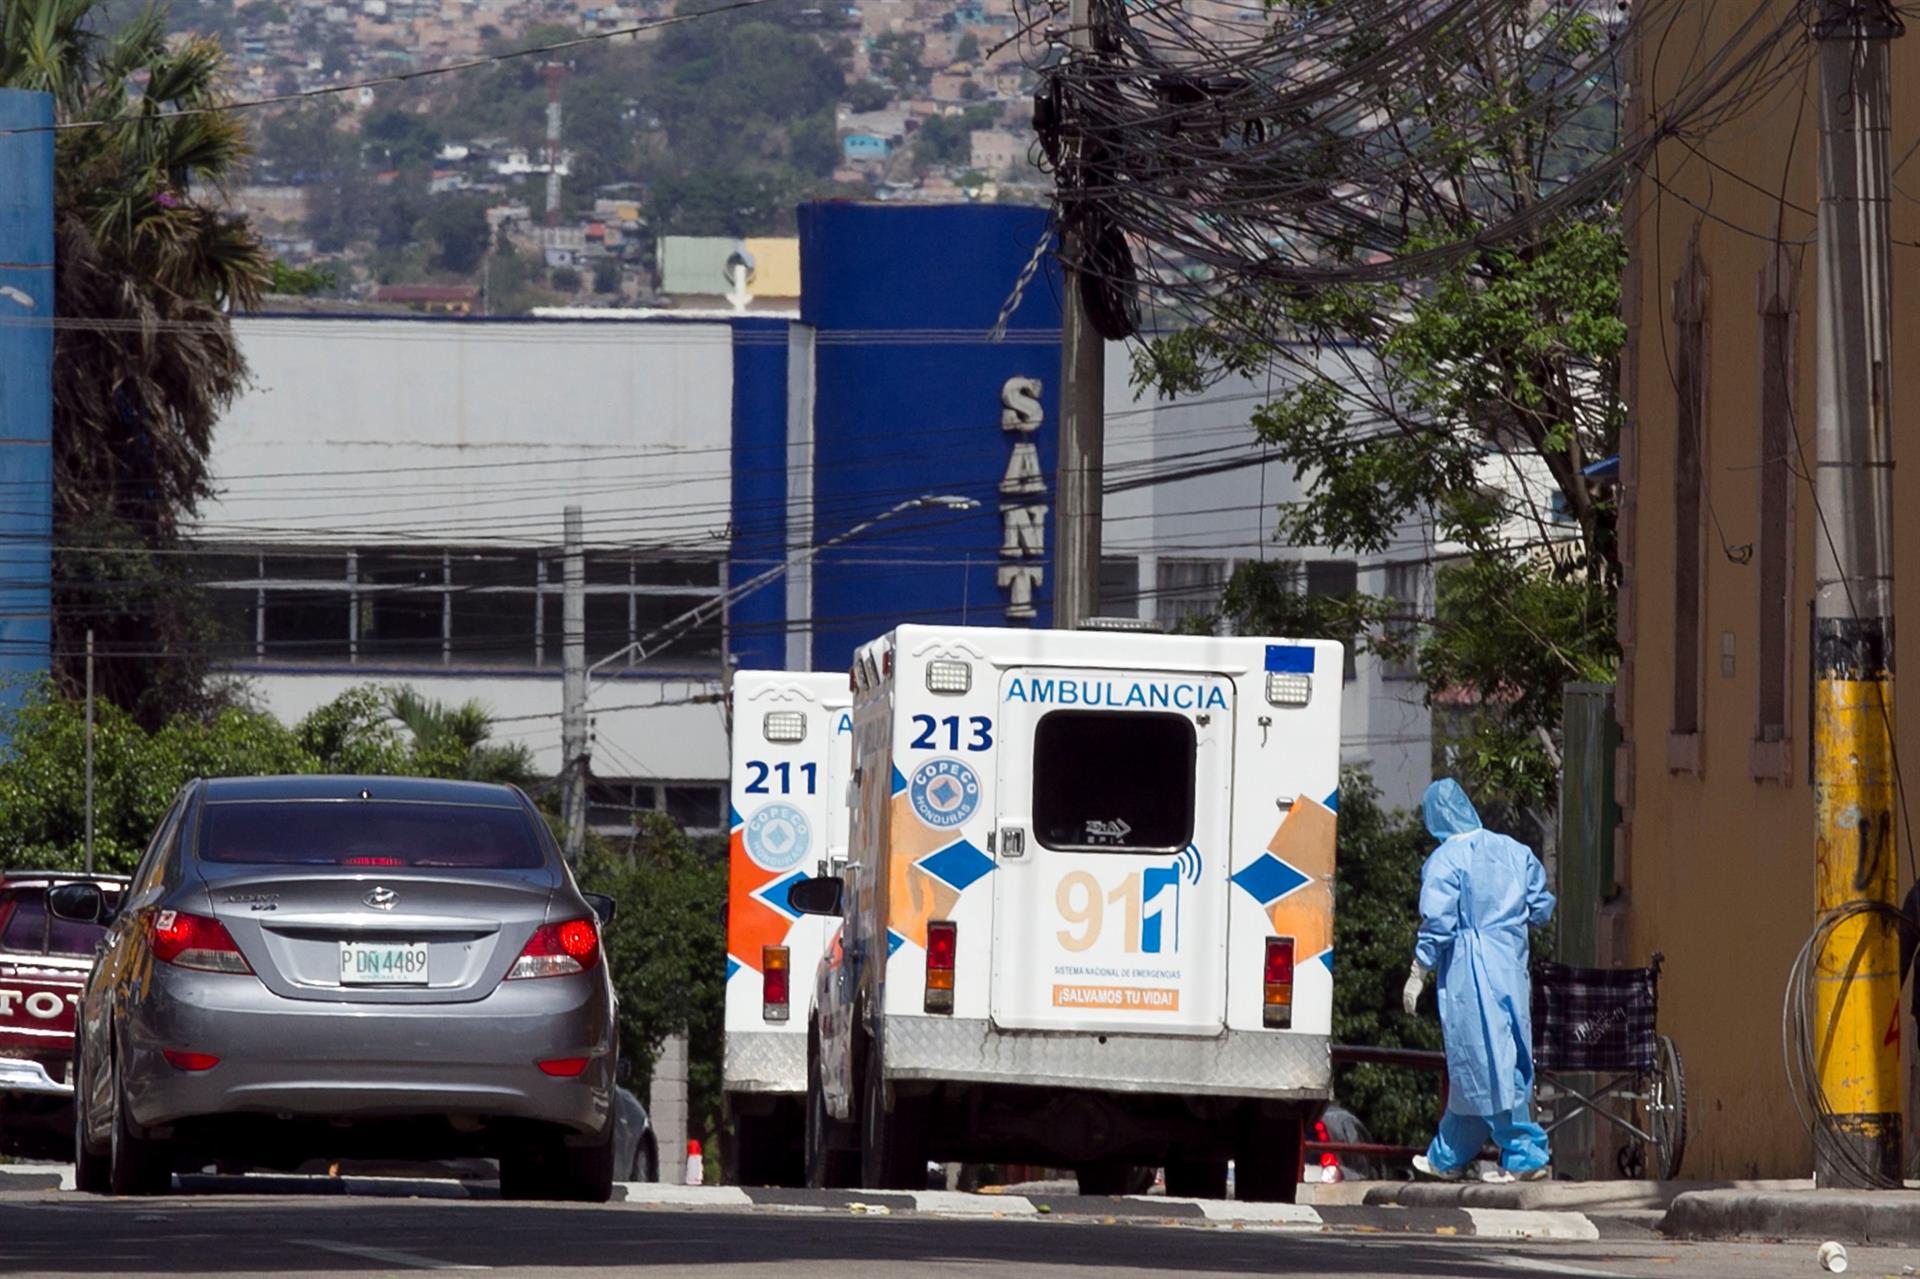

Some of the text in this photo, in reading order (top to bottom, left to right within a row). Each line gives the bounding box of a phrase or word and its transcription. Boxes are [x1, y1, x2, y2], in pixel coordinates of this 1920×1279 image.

[1006, 678, 1229, 710] AMBULANCIA
[910, 714, 993, 752] 213
[745, 761, 816, 794] 211
[915, 762, 977, 795] COPECO
[750, 807, 807, 834] COPECO
[916, 795, 971, 825] HONDURAS
[1056, 868, 1180, 953] 911
[383, 950, 426, 973] 4489
[1054, 966, 1181, 979] SISTEMA NACIONAL DE EMERGENCIAS
[0, 989, 79, 1019] TO
[1059, 987, 1173, 1006] ¡SALVAMOS TU VIDA!
